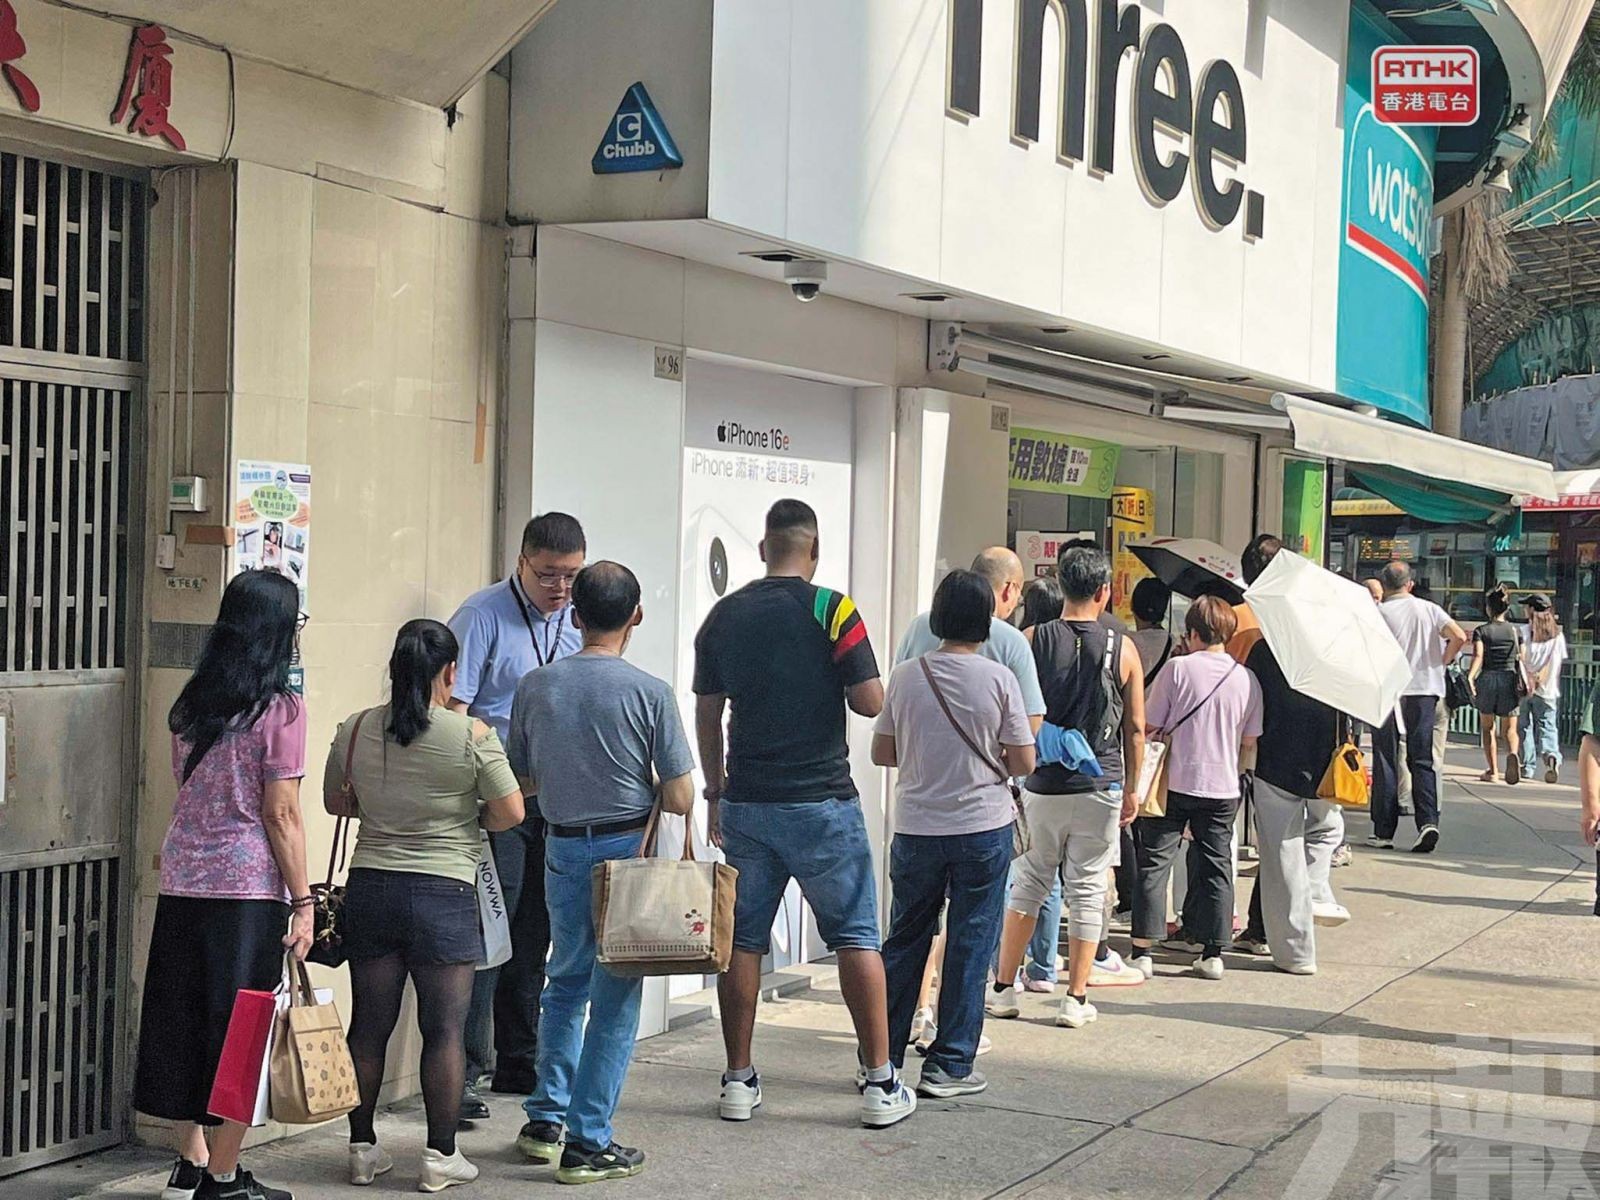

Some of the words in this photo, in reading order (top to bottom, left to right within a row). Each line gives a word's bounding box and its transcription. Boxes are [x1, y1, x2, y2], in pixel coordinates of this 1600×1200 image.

[603, 140, 655, 159] Chubb
[727, 422, 768, 448] iPhone
[770, 428, 789, 450] 16e
[692, 452, 733, 477] iPhone
[479, 861, 502, 919] NOWWA
